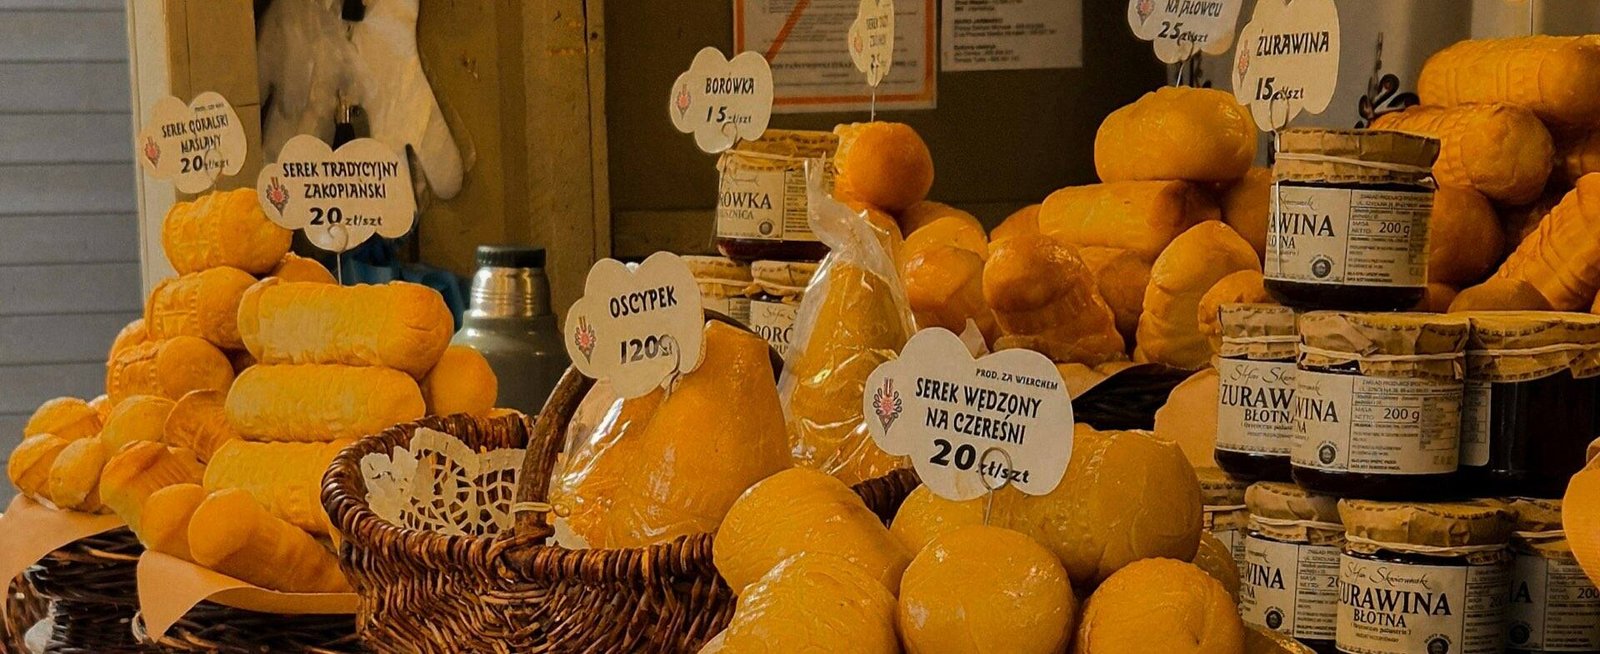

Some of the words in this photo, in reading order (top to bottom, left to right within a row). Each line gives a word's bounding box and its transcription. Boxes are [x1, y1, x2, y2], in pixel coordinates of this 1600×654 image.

[1158, 21, 1183, 39] 25
[1256, 28, 1329, 56] ŻURAWINA
[705, 72, 754, 94] BORÓWKA
[1255, 77, 1275, 100] 15
[706, 105, 727, 122] 15
[161, 122, 187, 138] SEREK
[188, 113, 229, 135] GÓRALSKI
[180, 155, 203, 174] 20
[282, 162, 319, 178] SEREK
[321, 161, 399, 181] TRADYCYJNY
[303, 178, 387, 199] ZAKOPIAŃSKI
[309, 207, 343, 226] 20
[345, 214, 383, 227] zł/szt
[1378, 222, 1402, 234] 200
[1403, 226, 1411, 239] g
[609, 285, 678, 319] OSCYPEK
[620, 335, 660, 365] 120
[975, 368, 999, 380] PROD.
[1001, 370, 1013, 383] ZA
[1015, 374, 1059, 391] WIERCHEM
[915, 377, 960, 404] SEREK
[963, 385, 1043, 420] WĘDZONY
[1384, 408, 1409, 420] 200
[1412, 411, 1420, 423] g
[925, 407, 949, 430] NA
[953, 413, 1027, 446] CZEREŚNI
[929, 439, 976, 471] 20
[1577, 587, 1600, 600] 200
[1353, 608, 1407, 629] BŁOTNA
